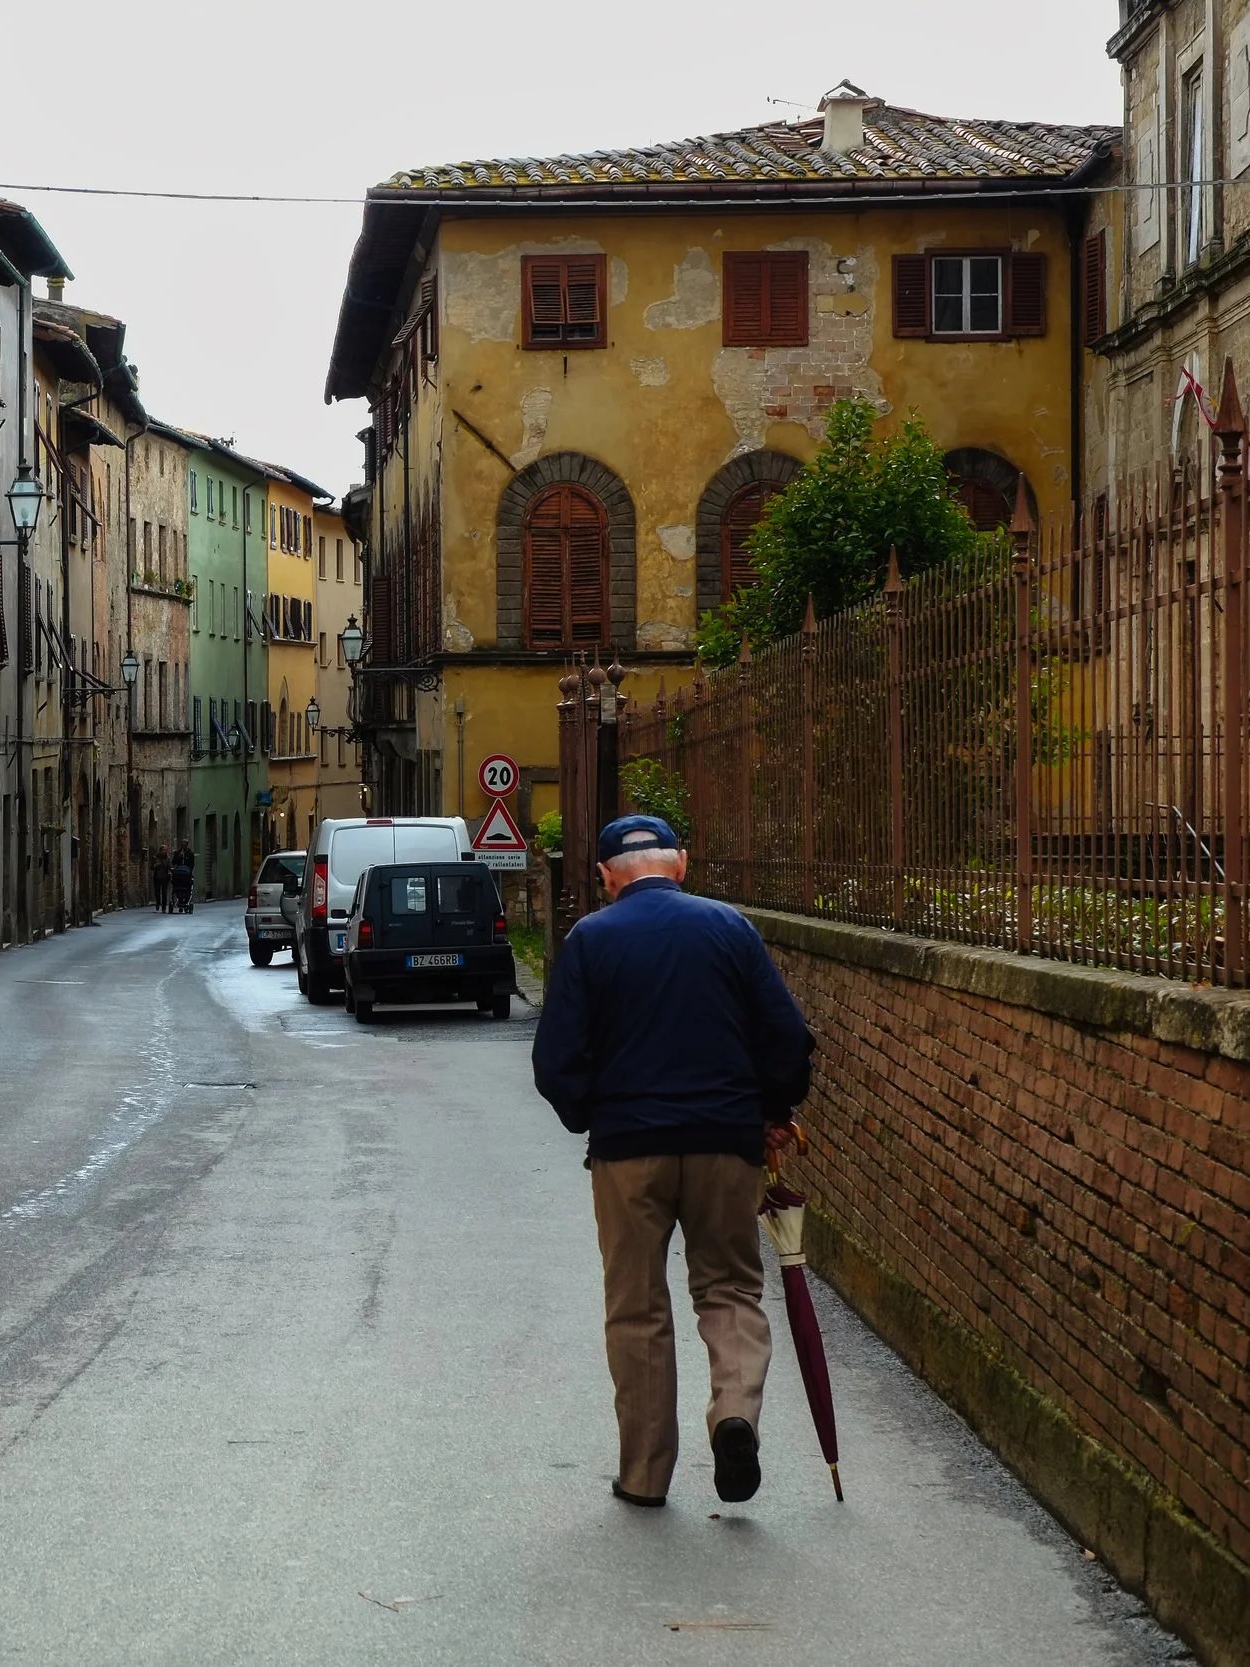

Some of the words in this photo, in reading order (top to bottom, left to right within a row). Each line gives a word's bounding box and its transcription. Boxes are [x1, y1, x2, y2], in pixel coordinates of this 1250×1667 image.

[487, 766, 512, 786] 20
[413, 956, 425, 967] BZ
[429, 954, 458, 966] 466RB
